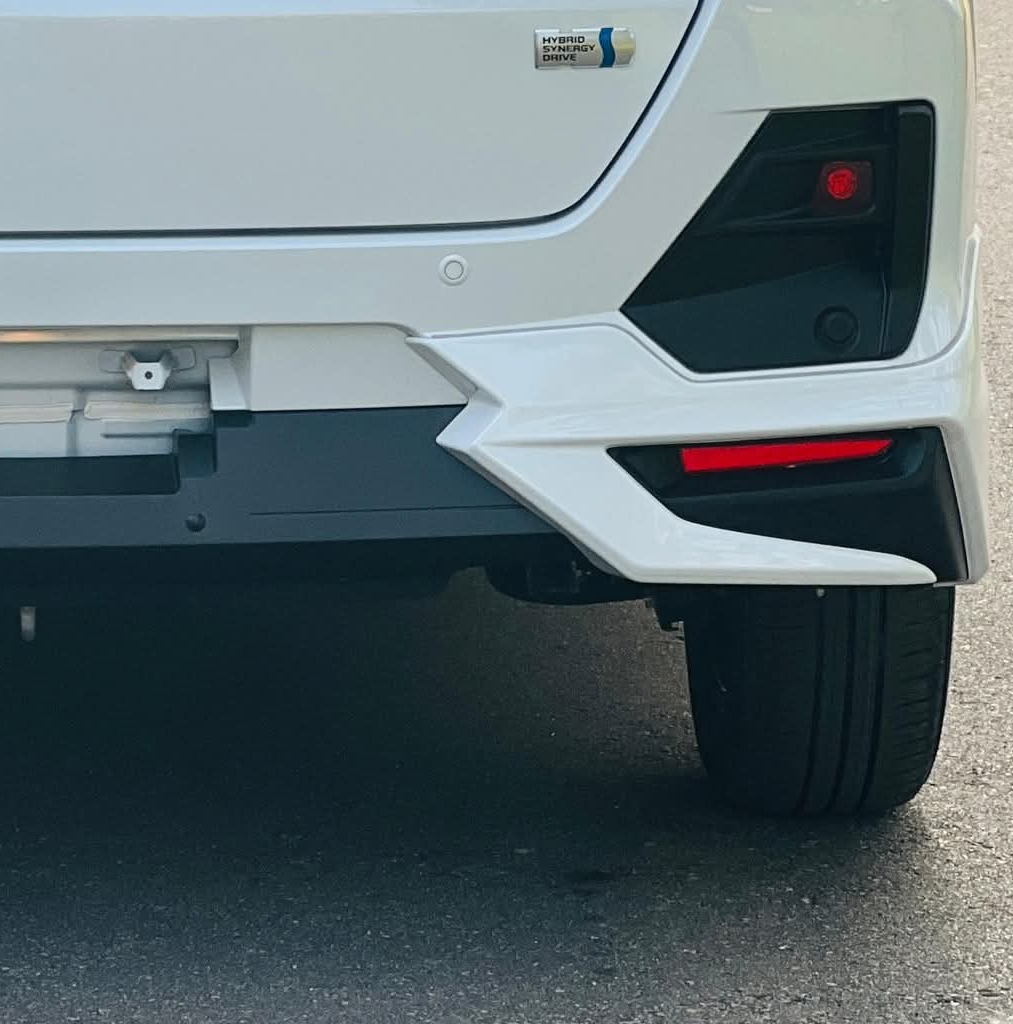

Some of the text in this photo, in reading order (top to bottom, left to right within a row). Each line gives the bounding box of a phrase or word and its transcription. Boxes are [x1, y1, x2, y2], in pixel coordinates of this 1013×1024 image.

[542, 36, 585, 45] HYBRID
[542, 44, 596, 53] SYNERGY
[542, 53, 577, 62] DRIVE
